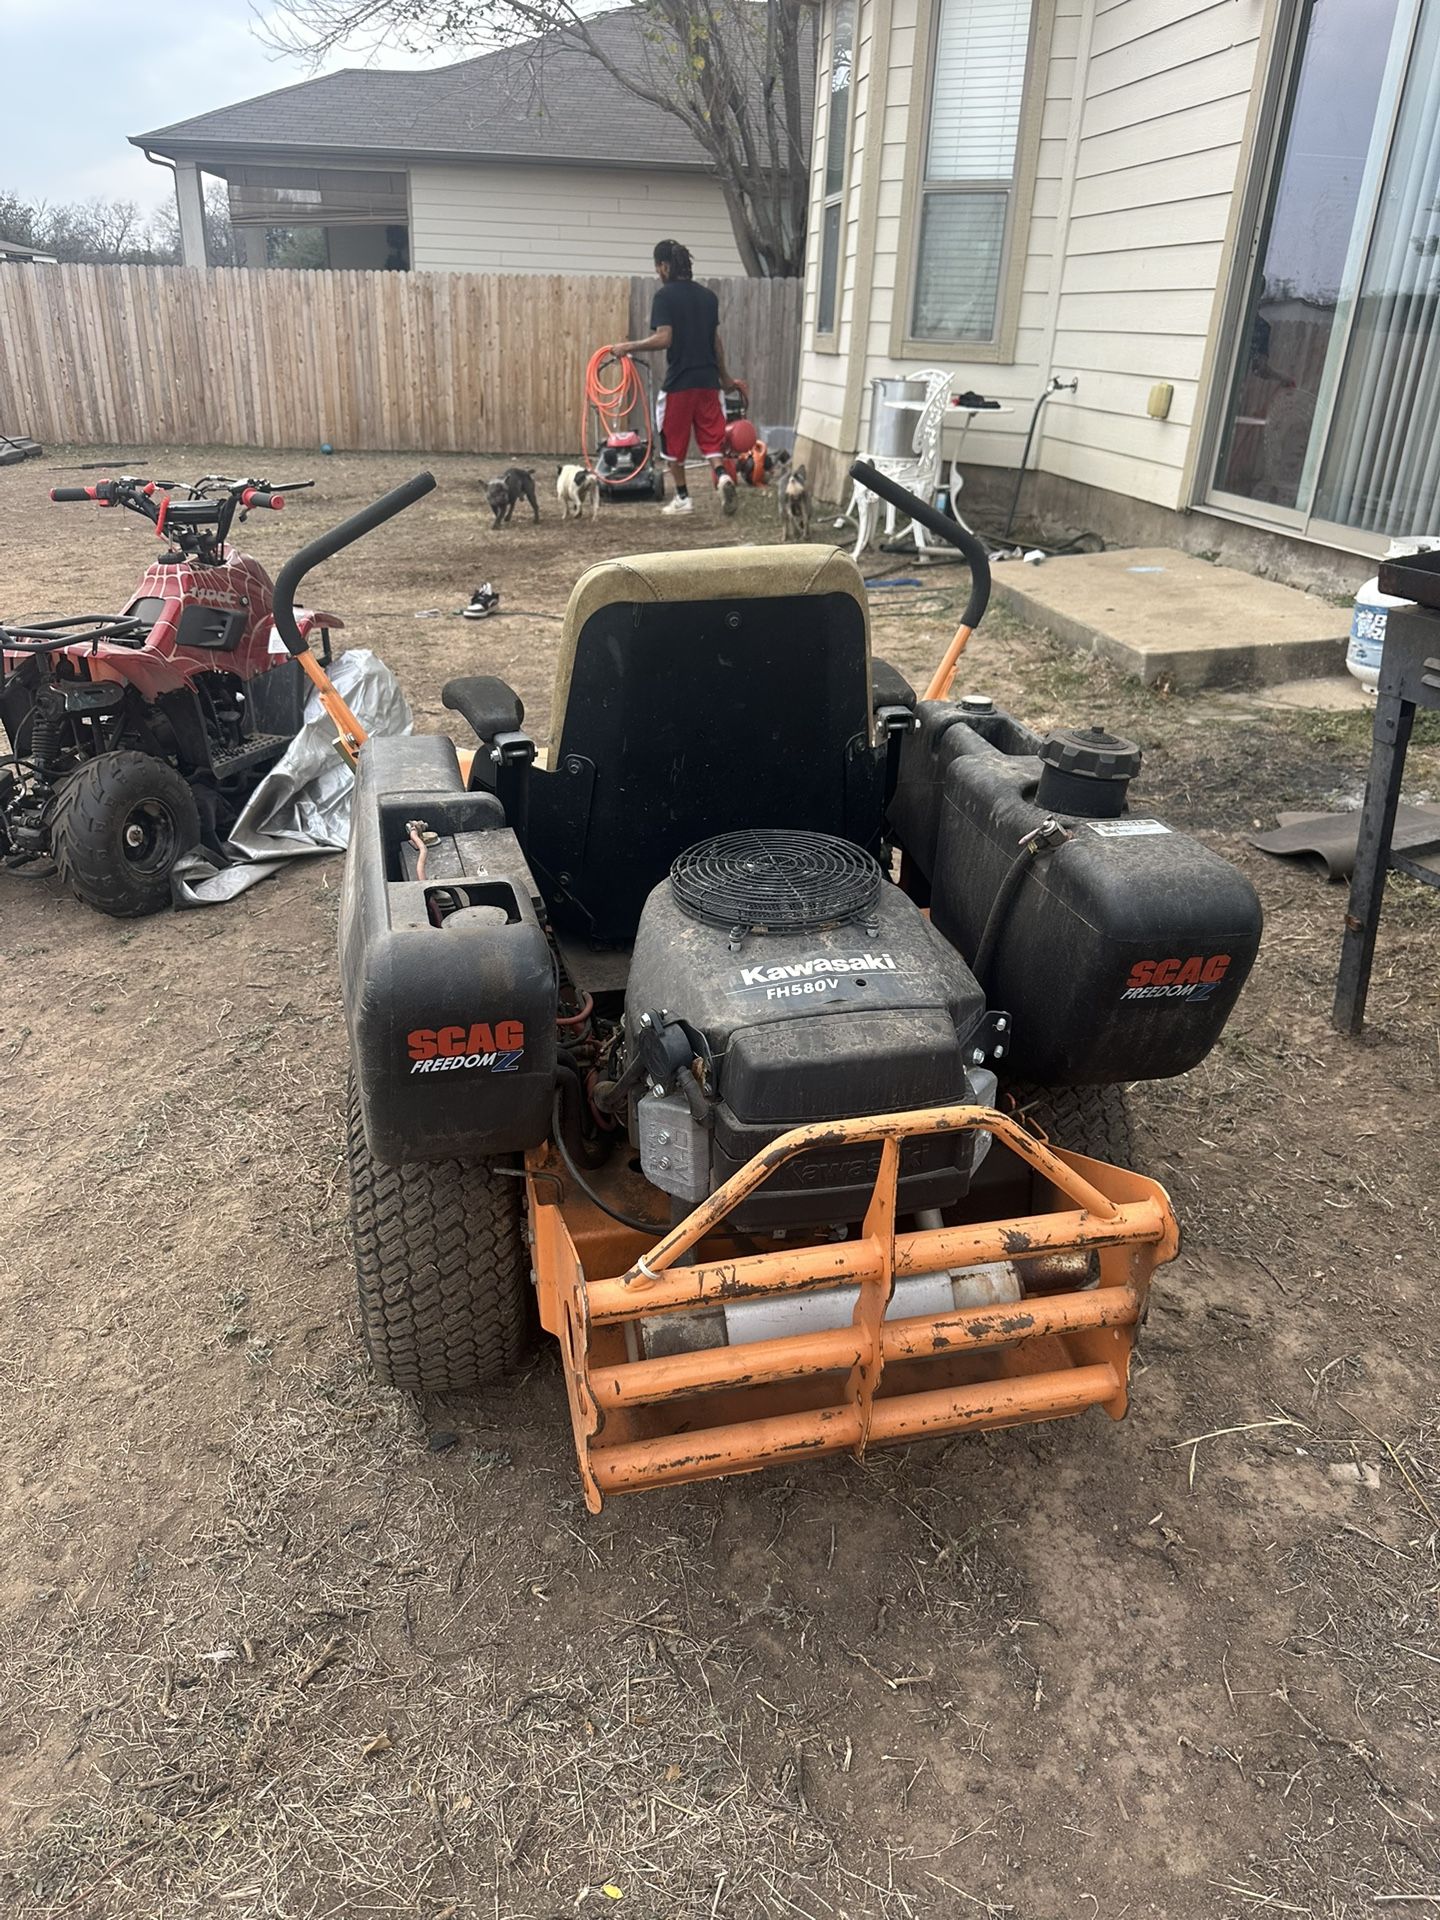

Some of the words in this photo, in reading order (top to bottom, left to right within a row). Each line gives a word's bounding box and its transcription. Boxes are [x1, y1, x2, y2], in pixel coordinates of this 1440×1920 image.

[740, 953, 897, 986] Kawasaki
[1126, 954, 1231, 988] SCAG
[766, 978, 839, 1000] FH580V
[407, 1020, 525, 1060] SCAG
[784, 1143, 930, 1186] Kawaski
